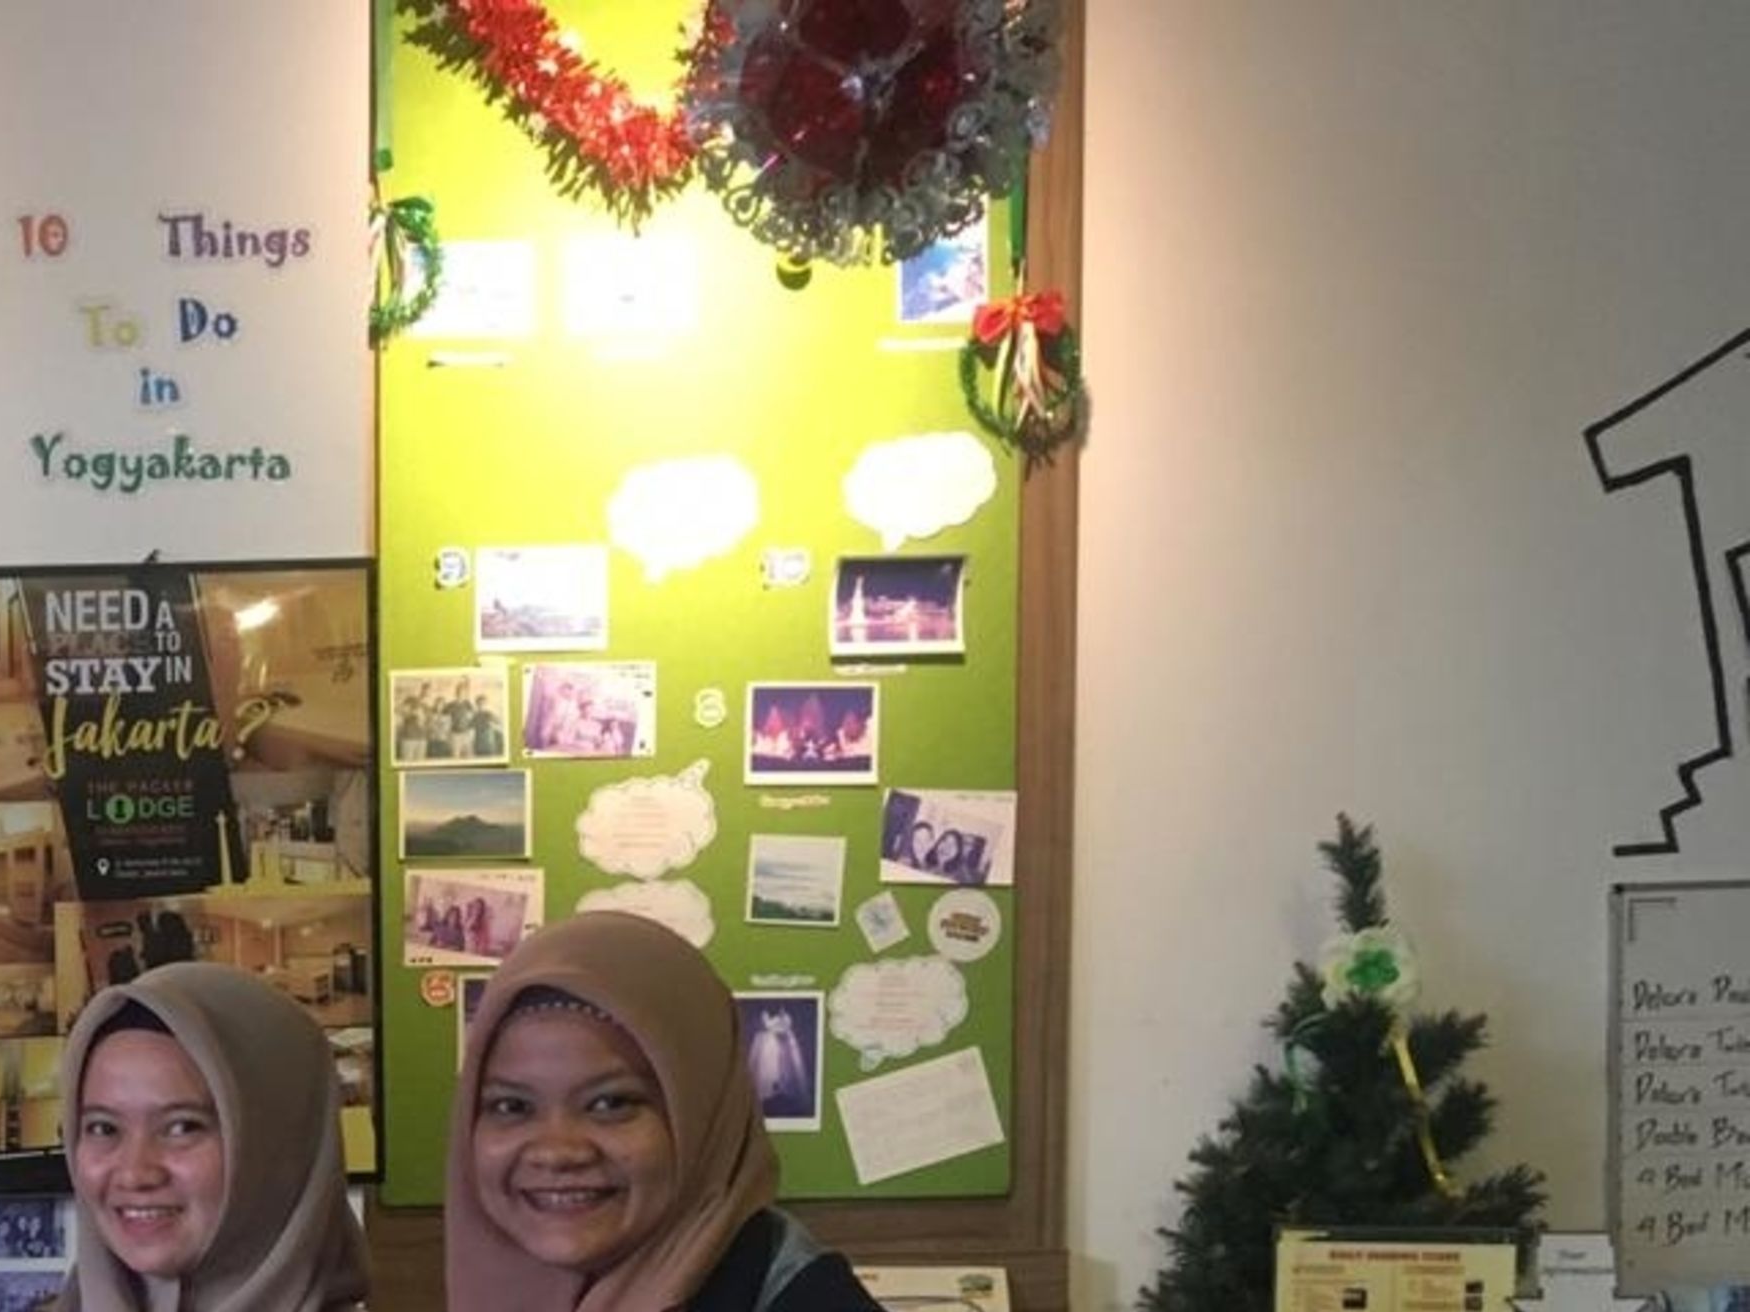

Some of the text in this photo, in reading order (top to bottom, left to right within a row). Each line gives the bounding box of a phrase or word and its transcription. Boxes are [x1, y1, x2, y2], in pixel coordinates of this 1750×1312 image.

[18, 213, 311, 268] 10 Things
[80, 299, 238, 348] To Do
[140, 369, 180, 405] in
[30, 433, 291, 492] Yogyakarta
[45, 590, 176, 632] NEED A
[154, 631, 182, 653] TO
[45, 656, 193, 696] STAY IN
[45, 690, 222, 780] Jakarta
